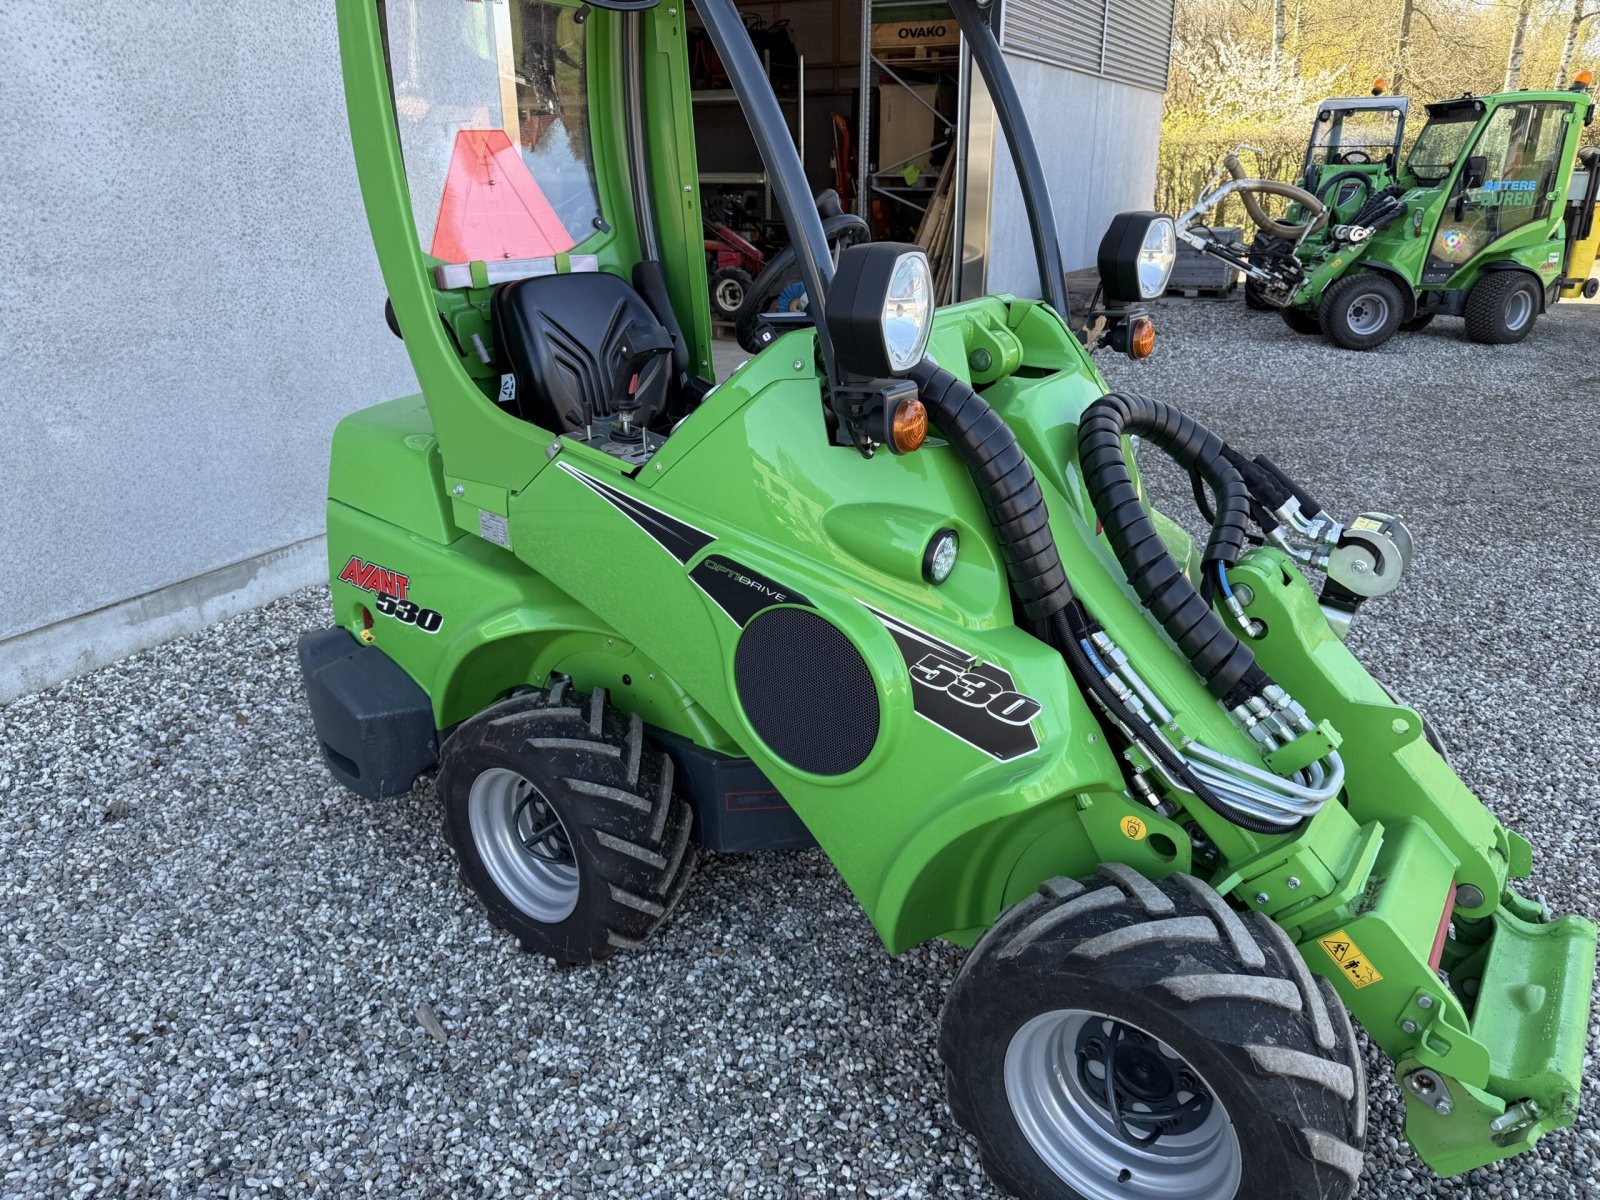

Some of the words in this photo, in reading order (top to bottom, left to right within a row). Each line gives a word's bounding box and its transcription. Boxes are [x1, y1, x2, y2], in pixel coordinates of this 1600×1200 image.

[898, 26, 946, 39] OVAKO
[1481, 191, 1534, 206] BUREN
[1483, 181, 1536, 191] BETERE
[337, 555, 410, 601] AVANT
[376, 591, 443, 633] 530
[909, 653, 1042, 726] 530
